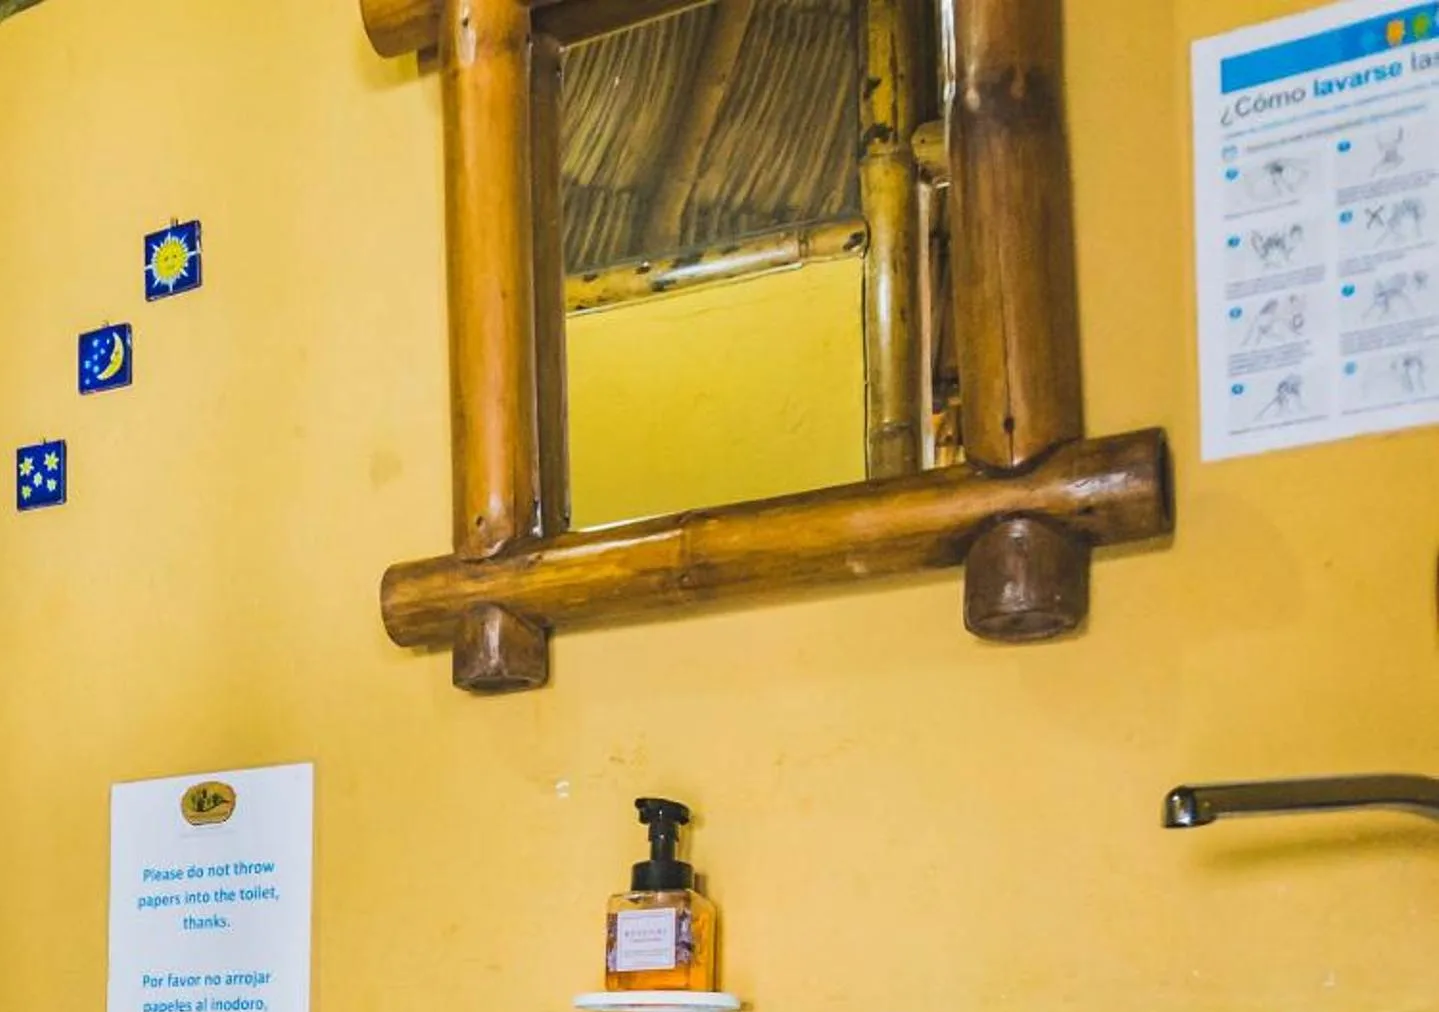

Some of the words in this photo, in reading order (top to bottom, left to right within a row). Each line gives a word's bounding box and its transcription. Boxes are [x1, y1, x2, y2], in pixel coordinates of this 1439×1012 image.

[1220, 87, 1306, 126] ¿Cómo
[1313, 61, 1403, 98] lavarse
[143, 867, 184, 882] Please
[187, 865, 204, 879] do
[208, 864, 229, 877] not
[234, 860, 275, 875] throw
[137, 894, 181, 909] papers
[185, 891, 210, 904] into
[214, 888, 236, 902] the
[240, 886, 279, 901] toilet,
[183, 914, 230, 930] thanks.
[142, 974, 163, 988] Por
[167, 973, 201, 987] favor
[204, 974, 221, 986] no
[225, 971, 271, 988] arrojar
[195, 998, 208, 1011] al
[211, 997, 268, 1012] inodoro,
